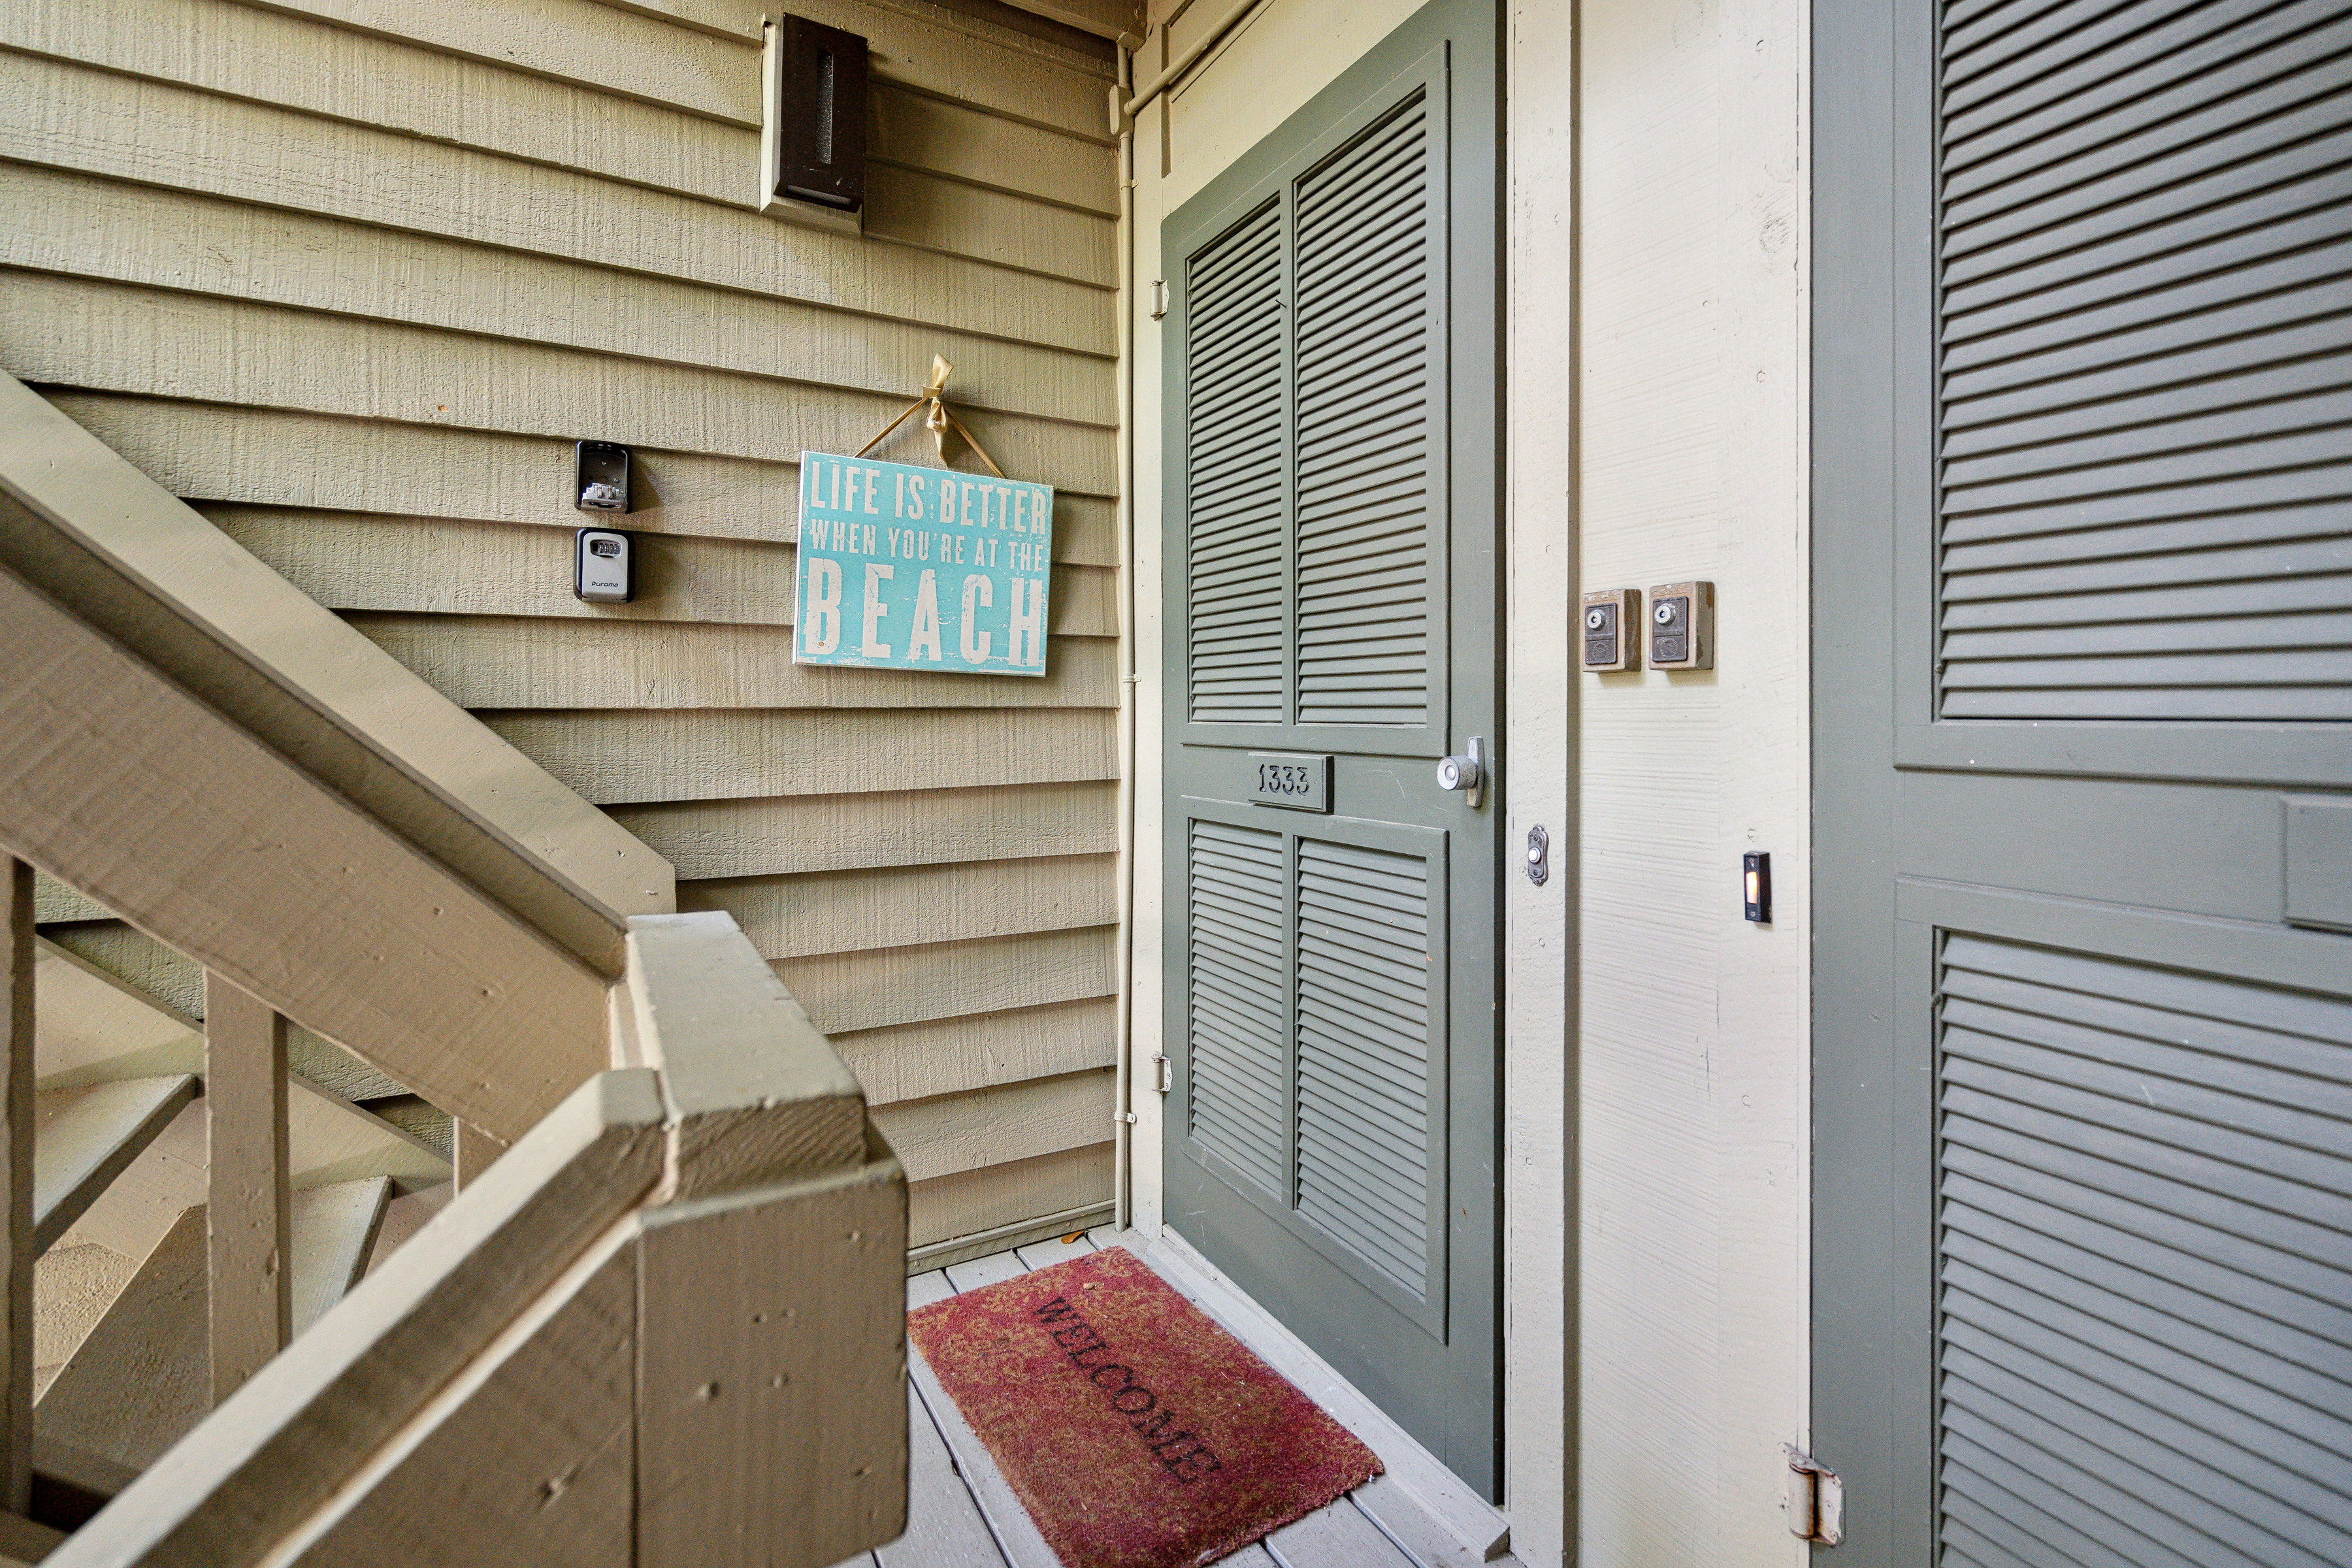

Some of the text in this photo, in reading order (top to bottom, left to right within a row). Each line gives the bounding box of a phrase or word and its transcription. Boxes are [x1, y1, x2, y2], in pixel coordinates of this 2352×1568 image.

[811, 461, 1047, 535] LIFE IS BETTER
[810, 519, 1044, 572] WHEN YOU'RE AT THE
[805, 557, 1043, 667] BEACH
[1259, 764, 1309, 796] 1333
[1033, 1296, 1221, 1484] WELCOME
